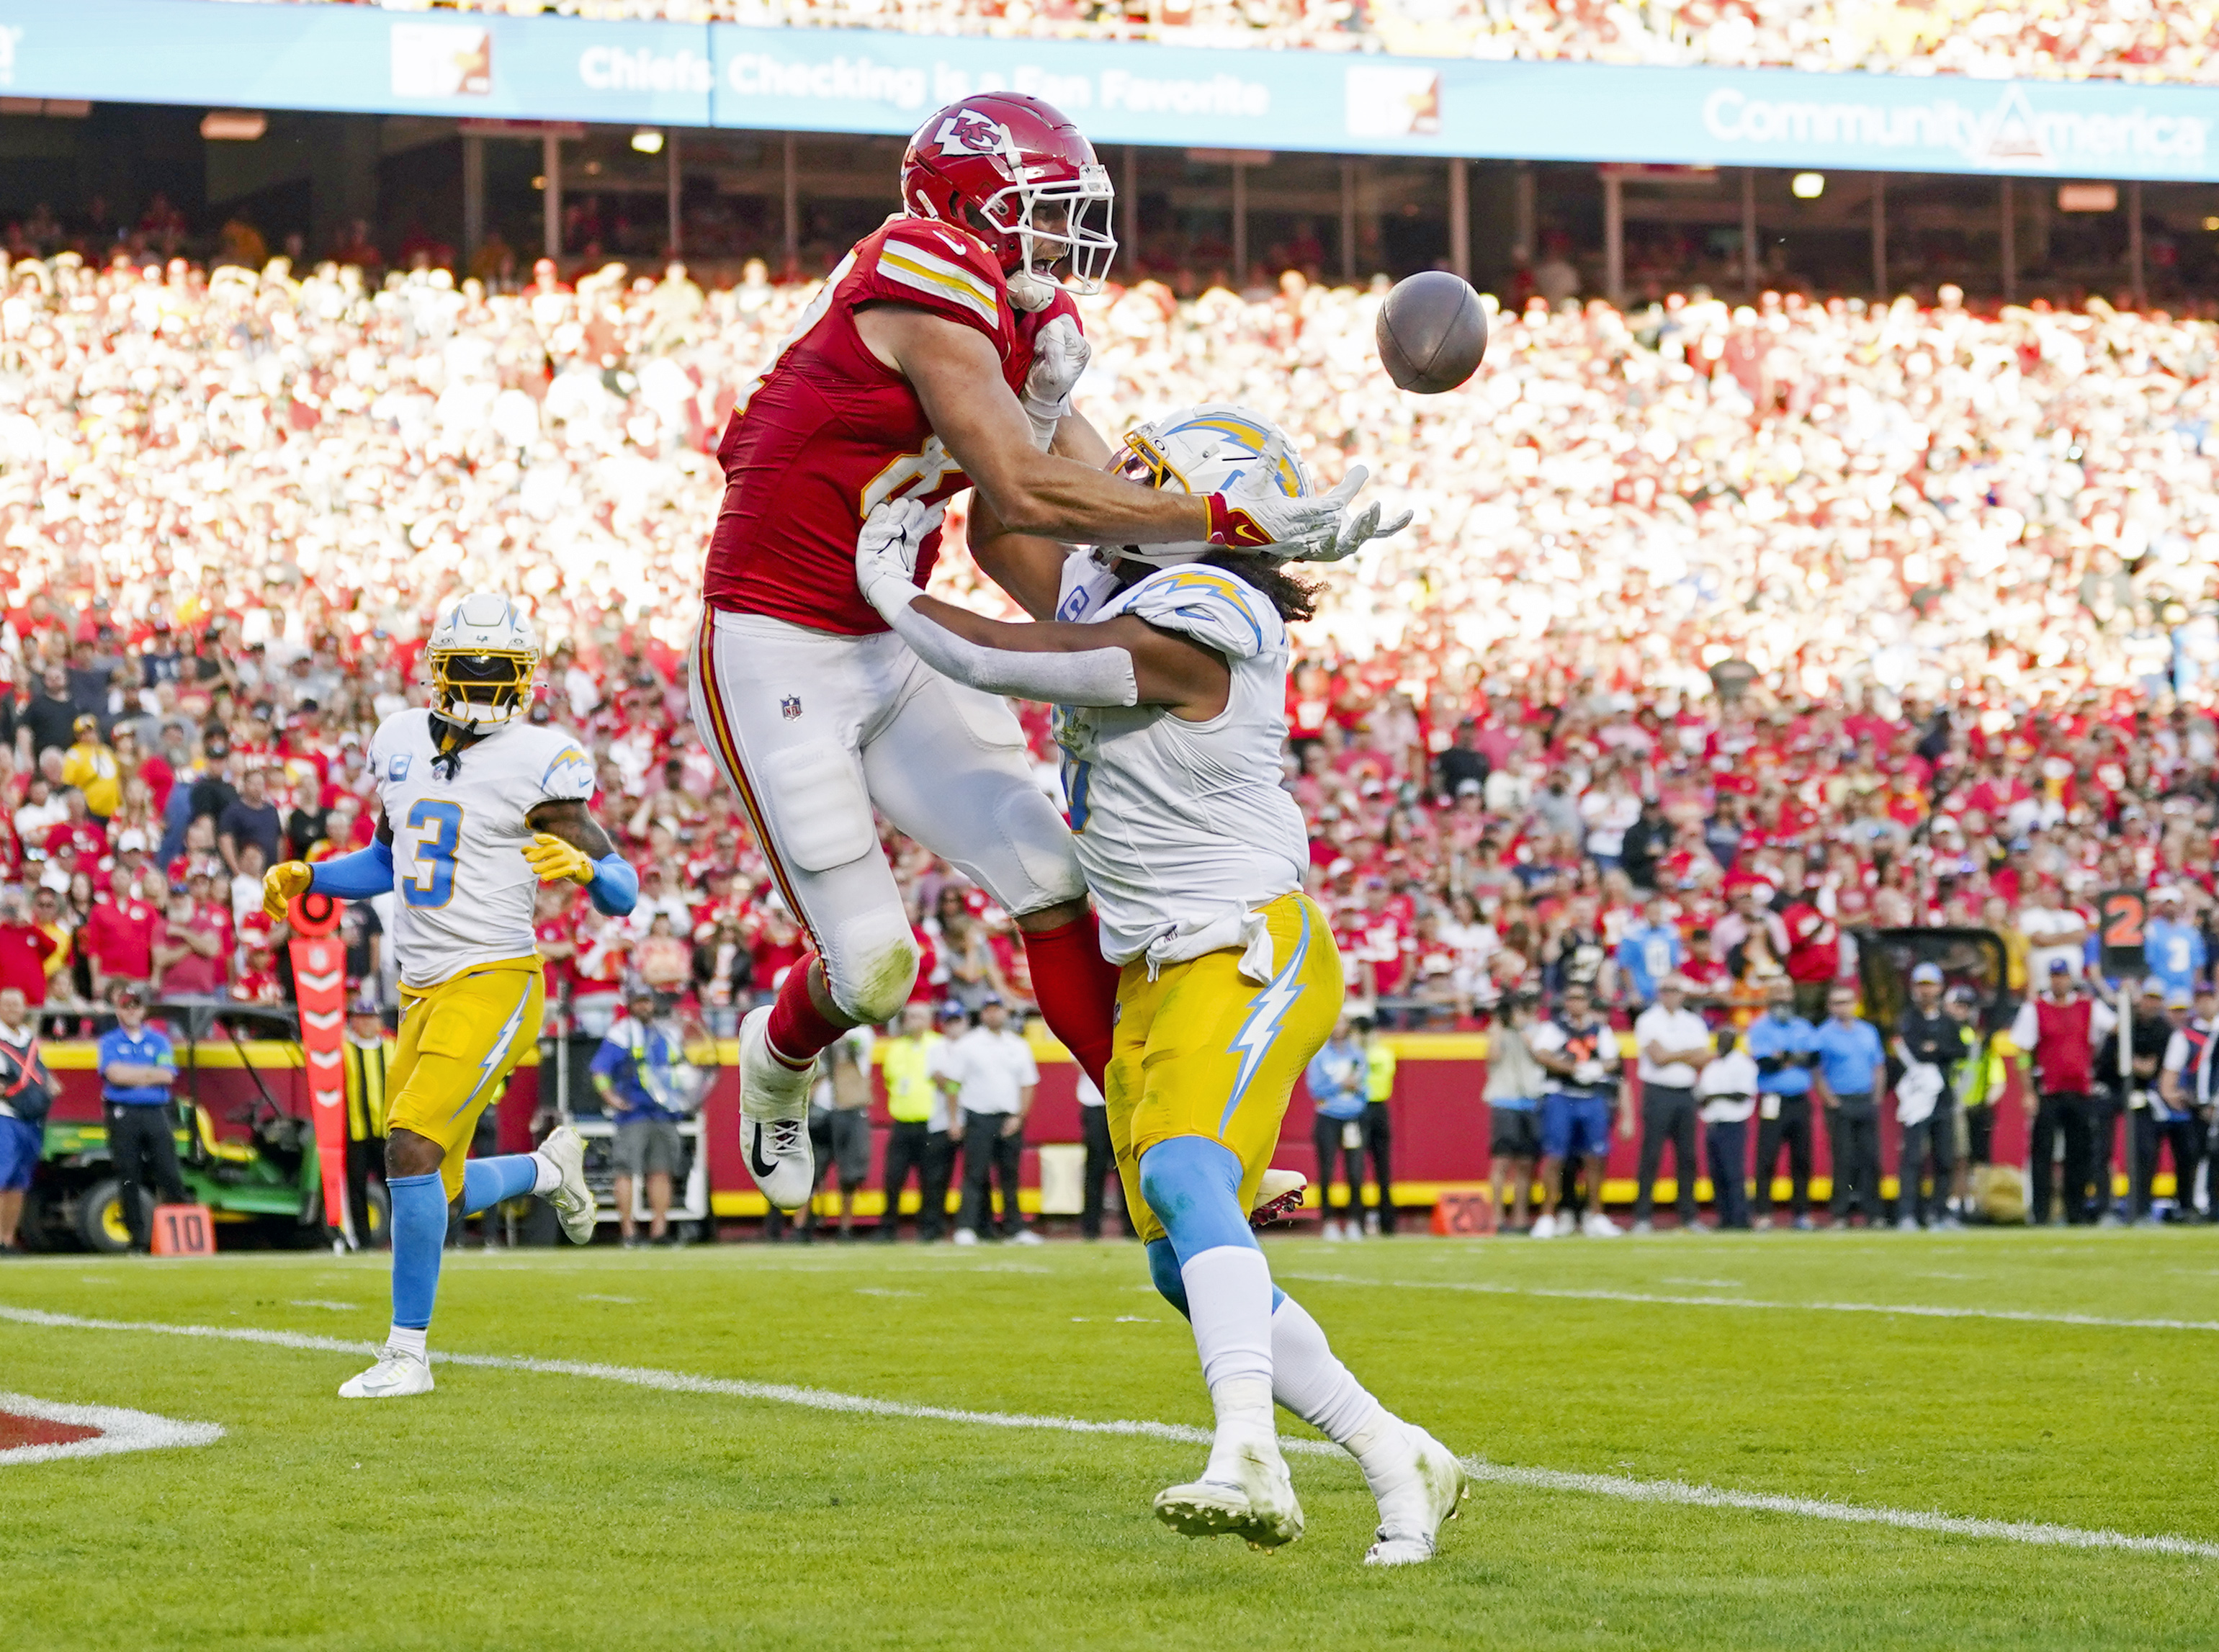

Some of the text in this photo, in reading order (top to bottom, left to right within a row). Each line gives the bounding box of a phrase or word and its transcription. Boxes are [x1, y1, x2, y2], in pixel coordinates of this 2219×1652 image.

[728, 53, 925, 109] Checking
[1100, 68, 1270, 116] Favorite
[949, 117, 1001, 152] KC
[785, 706, 801, 717] NFL
[403, 798, 465, 910] 3
[2104, 894, 2143, 947] 2
[168, 1215, 205, 1252] 10
